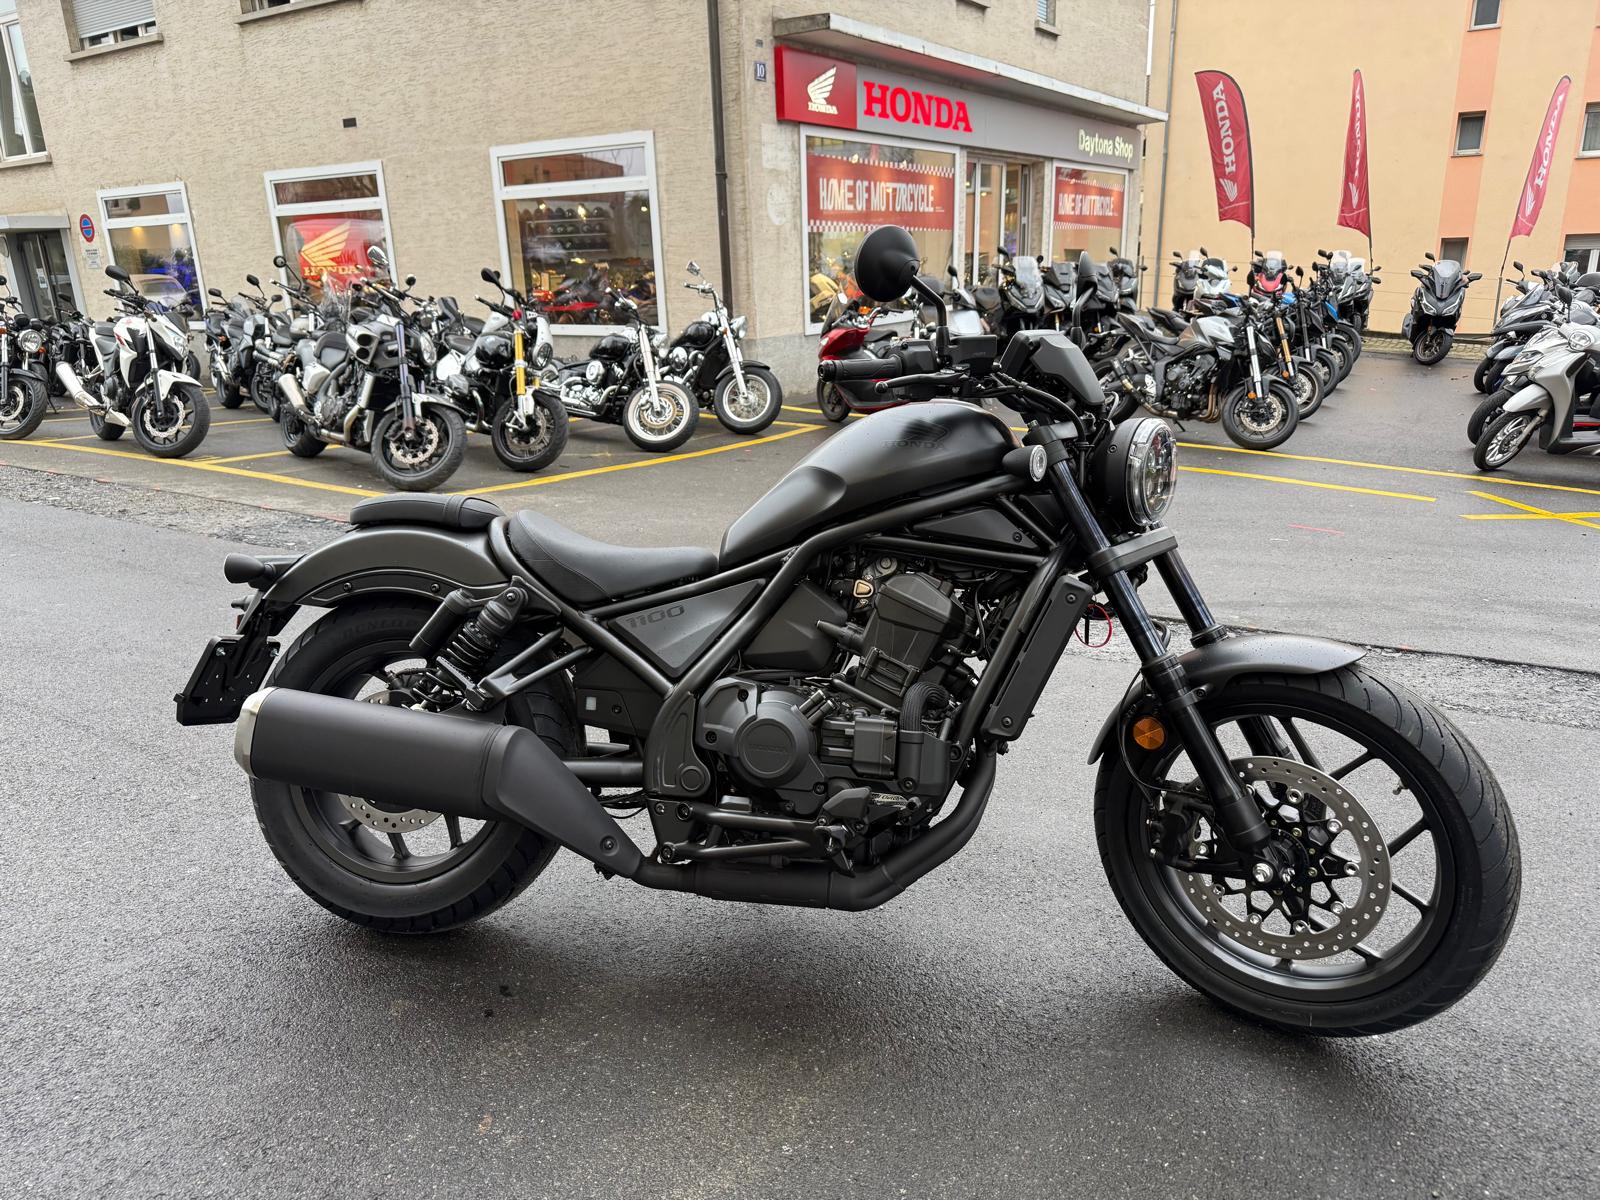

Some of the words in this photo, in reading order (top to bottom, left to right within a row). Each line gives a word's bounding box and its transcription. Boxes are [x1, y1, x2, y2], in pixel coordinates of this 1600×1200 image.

[756, 63, 765, 78] 10
[807, 101, 839, 115] HONDA
[863, 81, 973, 133] HONDA
[1212, 80, 1237, 175] HONDA
[1534, 93, 1565, 188] HONDA
[1079, 129, 1113, 157] Daytona
[1114, 135, 1134, 163] Shop
[819, 176, 855, 211] HOME
[855, 179, 869, 211] OF
[870, 181, 935, 213] MOTORCYCLE
[303, 265, 361, 276] HONDA
[882, 439, 946, 450] HONDA
[625, 604, 686, 629] 1100
